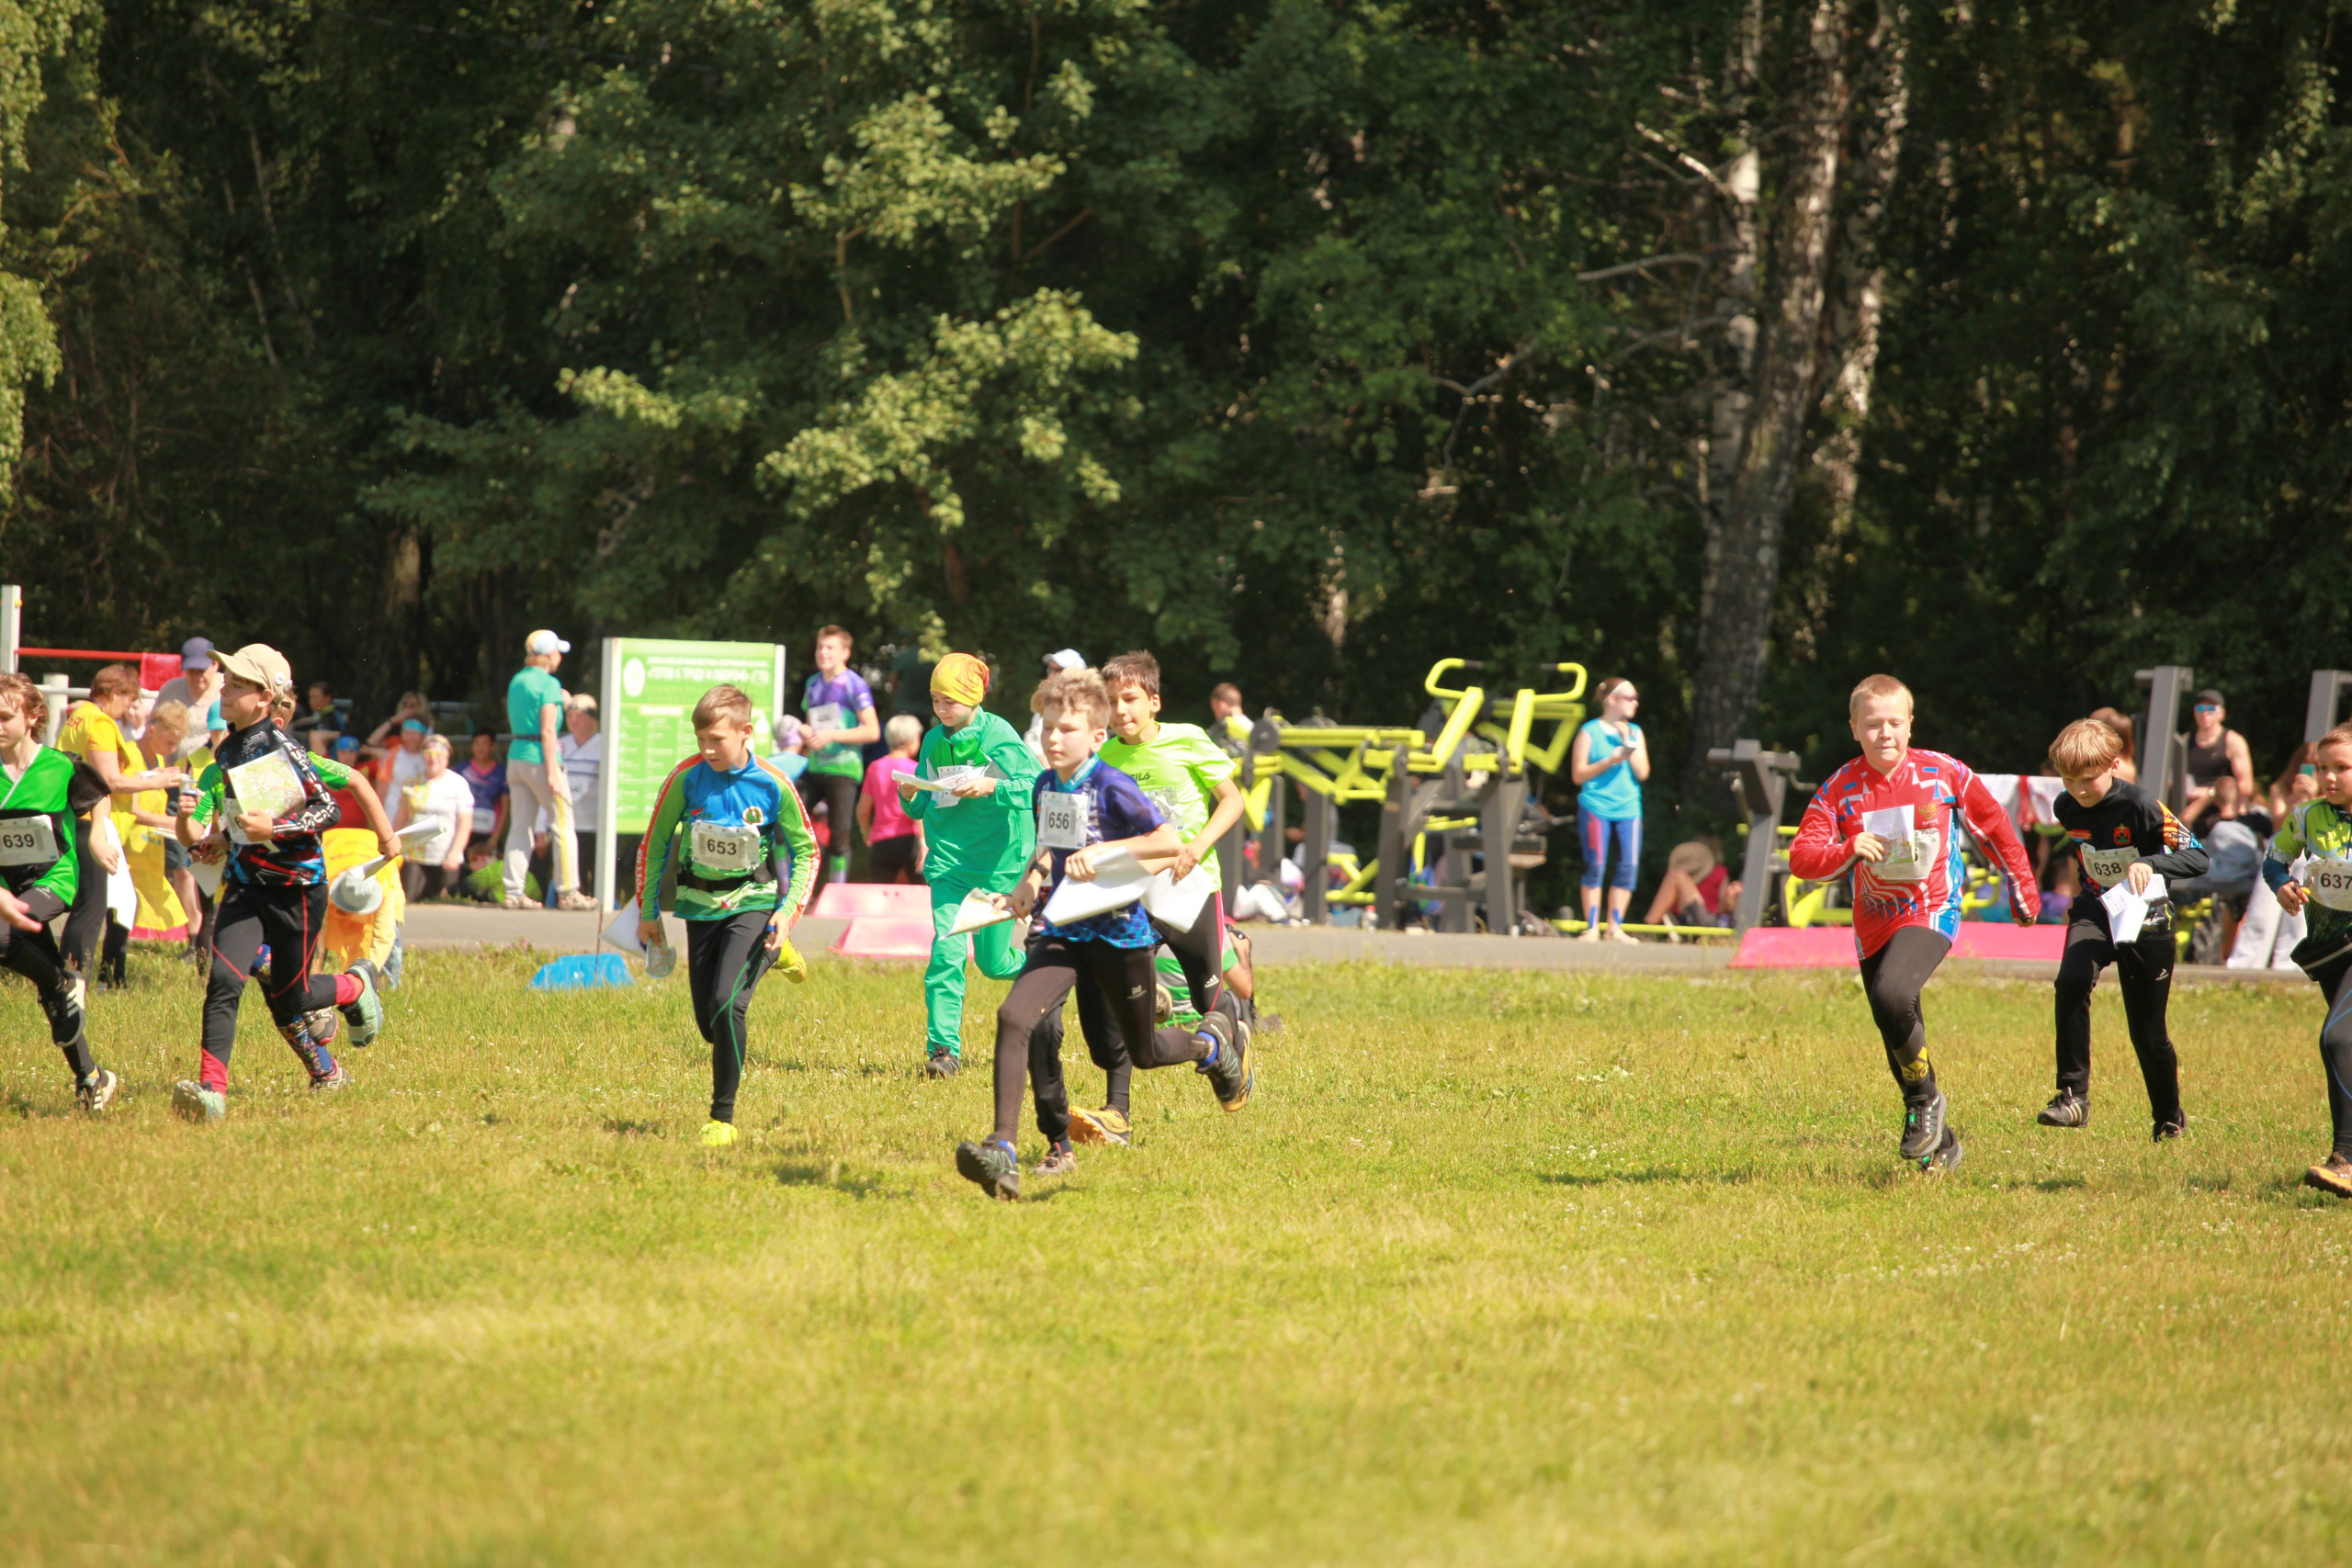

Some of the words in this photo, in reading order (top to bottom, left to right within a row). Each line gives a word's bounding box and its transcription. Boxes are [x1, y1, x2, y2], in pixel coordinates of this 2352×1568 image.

[1048, 811, 1069, 829] 656
[3, 833, 35, 848] 639
[707, 838, 737, 856] 653
[2093, 862, 2122, 876] 638
[2320, 873, 2352, 889] 637
